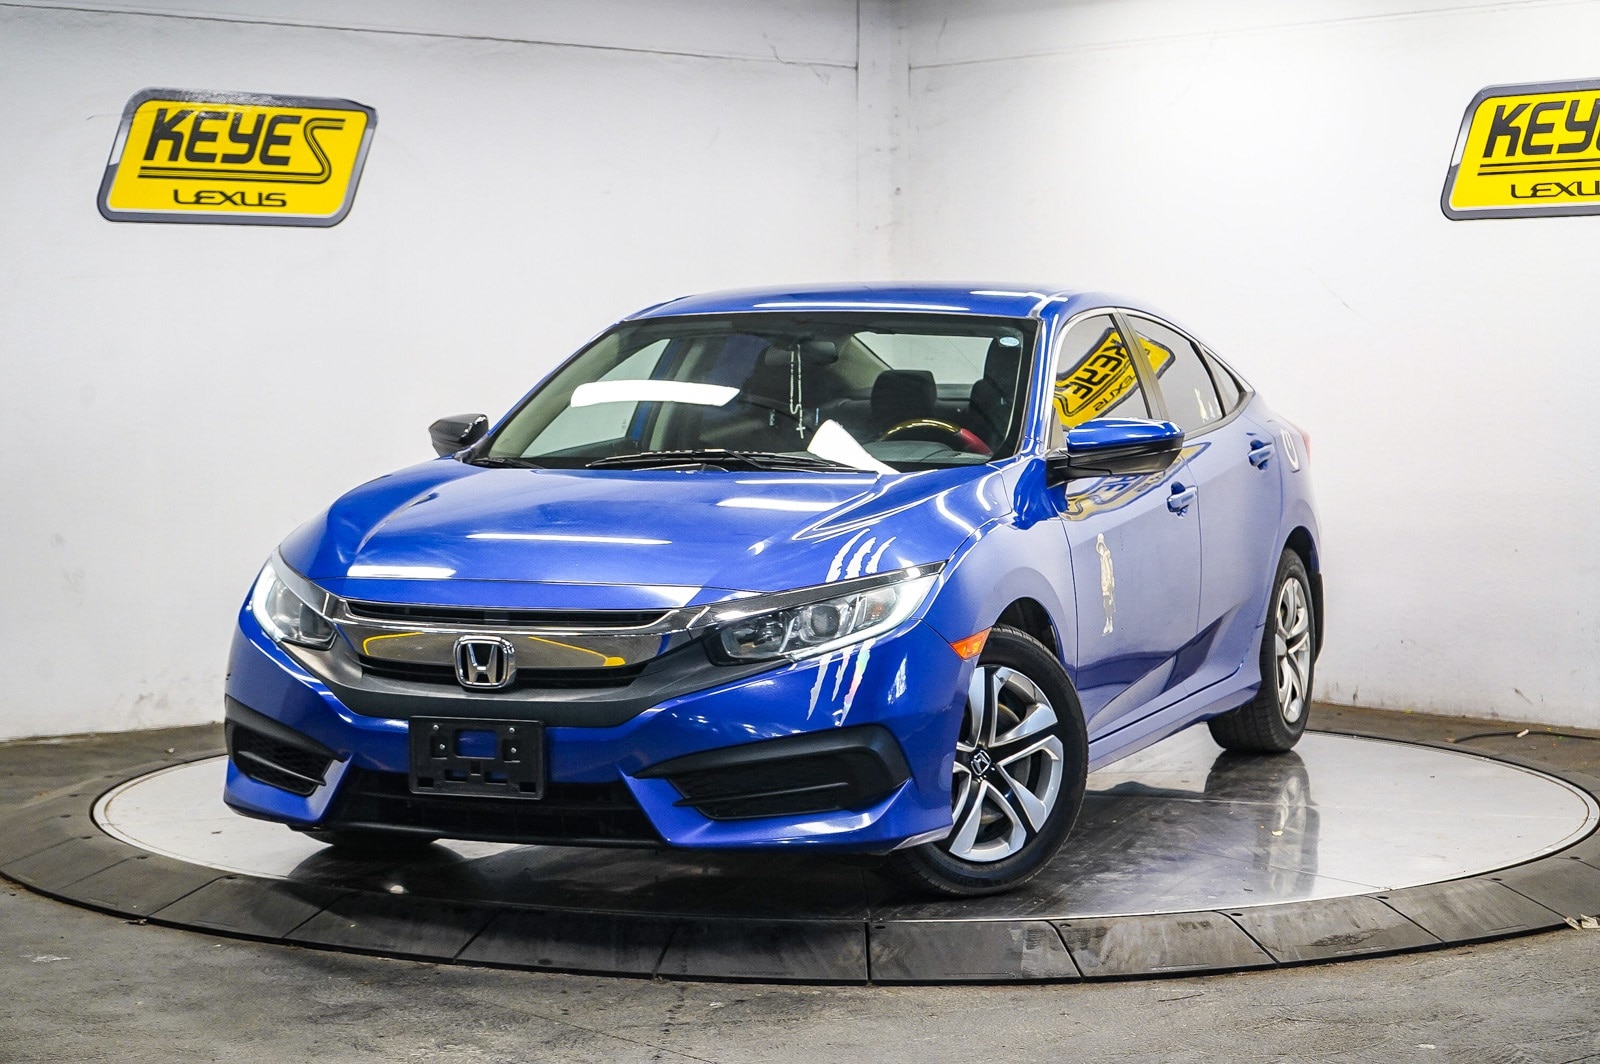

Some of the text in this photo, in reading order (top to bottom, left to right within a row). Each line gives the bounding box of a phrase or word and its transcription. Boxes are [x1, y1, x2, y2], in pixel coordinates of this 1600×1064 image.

[143, 108, 346, 184] KEYES
[1482, 98, 1600, 158] KEY
[173, 189, 287, 207] LEXUS
